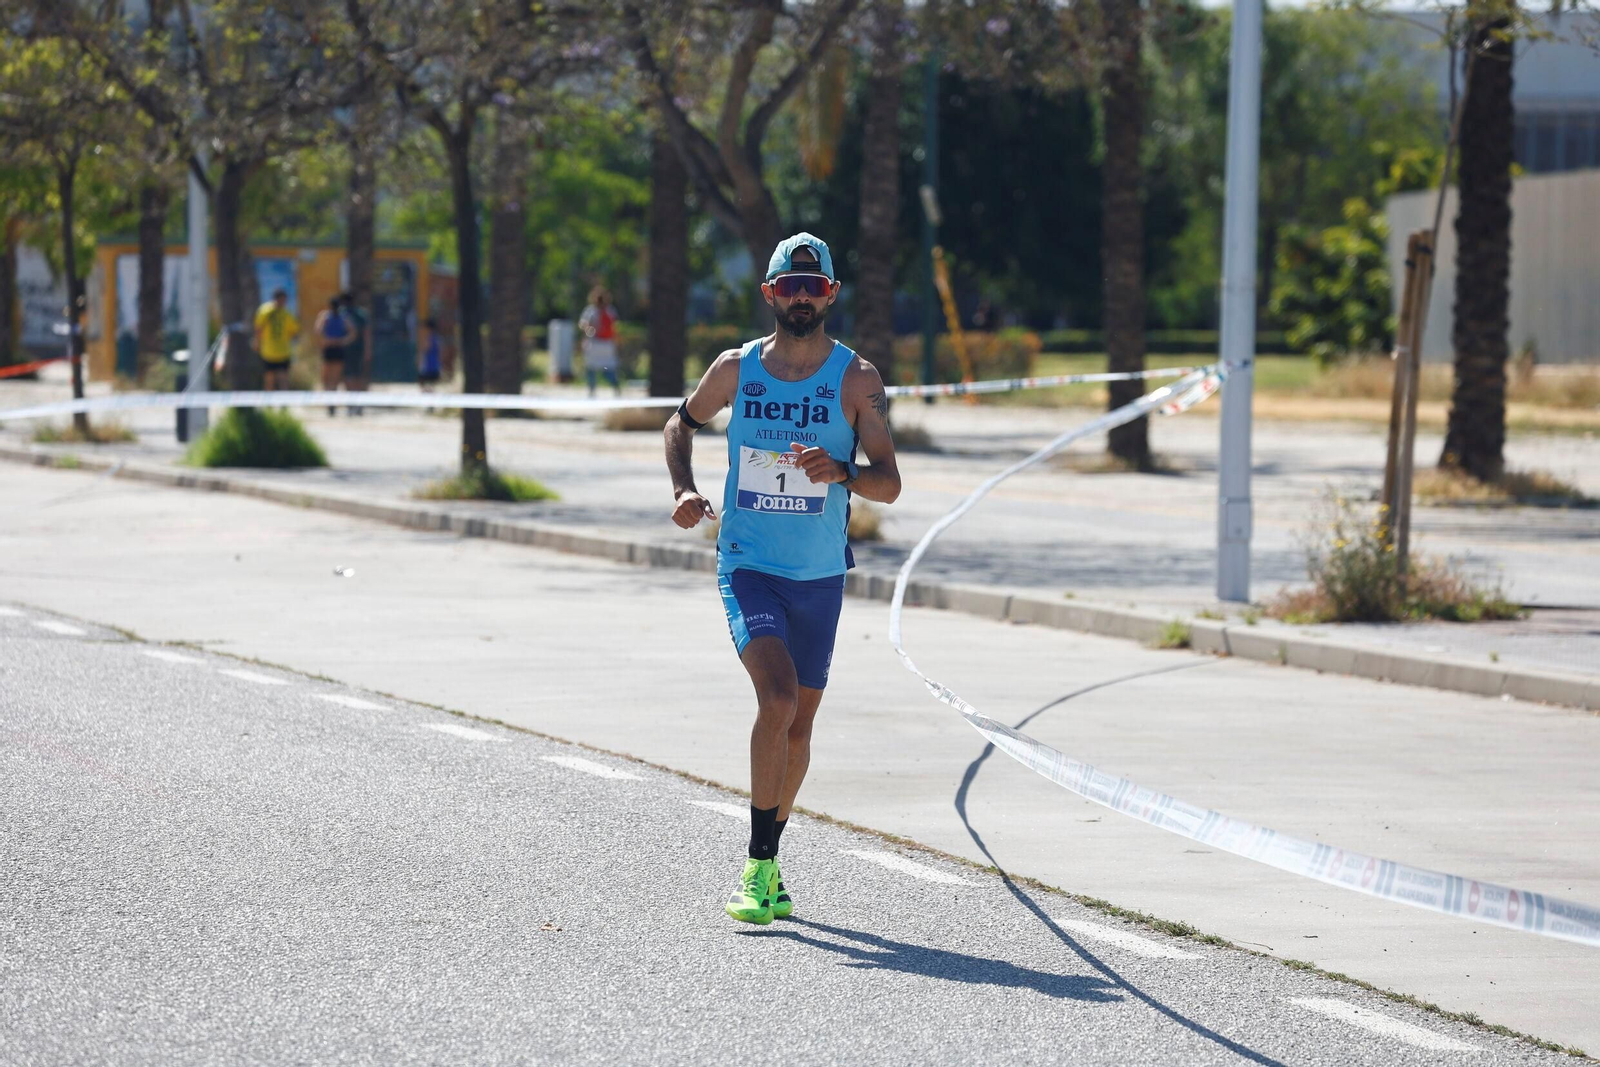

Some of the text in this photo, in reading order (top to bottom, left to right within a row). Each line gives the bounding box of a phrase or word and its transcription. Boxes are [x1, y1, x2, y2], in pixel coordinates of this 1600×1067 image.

[743, 383, 767, 395] TROPS
[743, 396, 830, 428] nerja
[755, 428, 818, 442] ATLETISMO
[775, 472, 786, 493] 1
